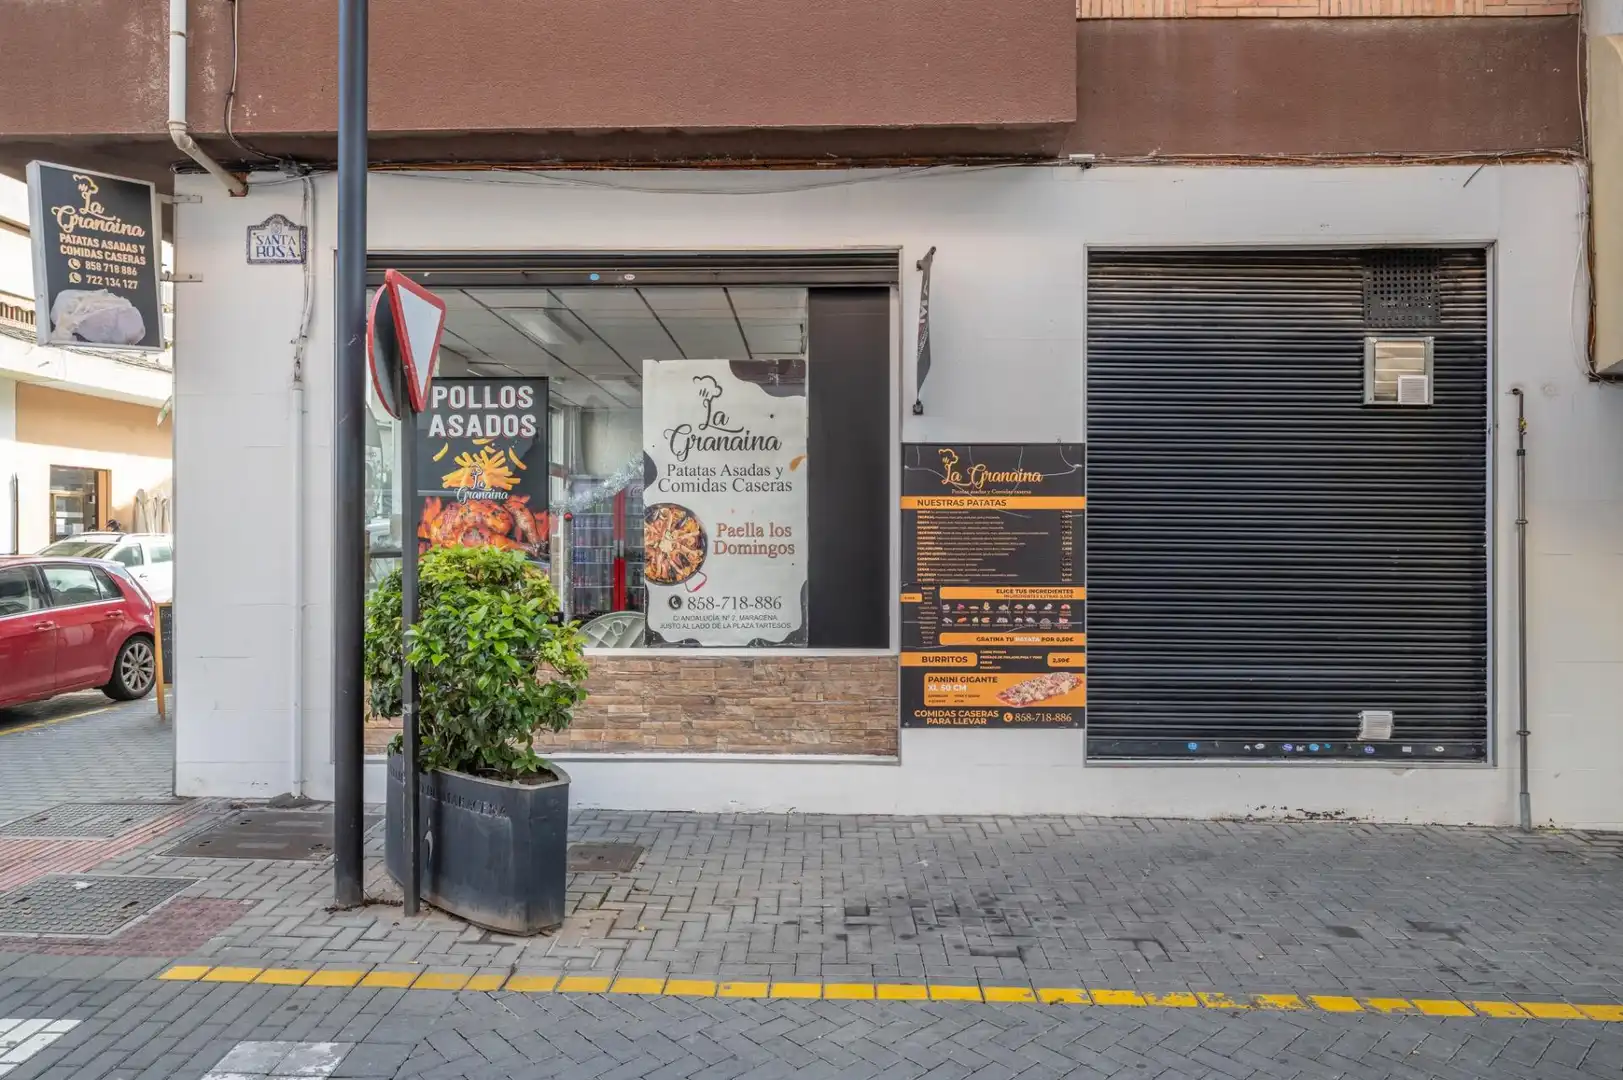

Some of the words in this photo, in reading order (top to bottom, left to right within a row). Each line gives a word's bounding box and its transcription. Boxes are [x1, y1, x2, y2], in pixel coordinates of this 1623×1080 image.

[79, 190, 116, 220] La
[51, 205, 146, 237] Granaina
[59, 233, 99, 247] PATATAS
[101, 240, 138, 252] ASADAS
[139, 245, 146, 254] Y
[256, 235, 296, 246] SANTA
[60, 245, 103, 259] COMIDAS
[104, 251, 146, 265] CASERAS
[256, 246, 296, 257] ROSA
[85, 260, 102, 271] 858
[104, 263, 120, 273] 718
[121, 265, 137, 276] 886
[86, 275, 103, 285] 722
[105, 277, 121, 287] 134
[122, 279, 138, 290] 127
[432, 385, 534, 409] POLLOS
[699, 399, 744, 433] La
[429, 414, 537, 437] ASADOS
[663, 424, 782, 462] Granaina
[667, 464, 716, 477] Patatas
[721, 463, 771, 477] Asadas
[776, 466, 784, 480] y
[941, 462, 973, 486] La
[967, 463, 1044, 489] Granaina
[658, 478, 727, 492] Comidas
[732, 477, 792, 492] Caseras
[917, 499, 965, 507] NUESTRAS
[966, 499, 1007, 507] PATATAS
[716, 522, 764, 538] Paella
[769, 522, 792, 538] los
[713, 540, 795, 558] Domingos
[687, 596, 782, 610] 858-718-886
[921, 655, 968, 664] BURRITOS
[928, 684, 940, 692] XL
[952, 684, 968, 692] CM
[960, 676, 998, 684] GIGANTE
[914, 709, 957, 718] COMIDAS
[958, 709, 999, 718] CASERAS
[1014, 712, 1072, 722] 858-718-886
